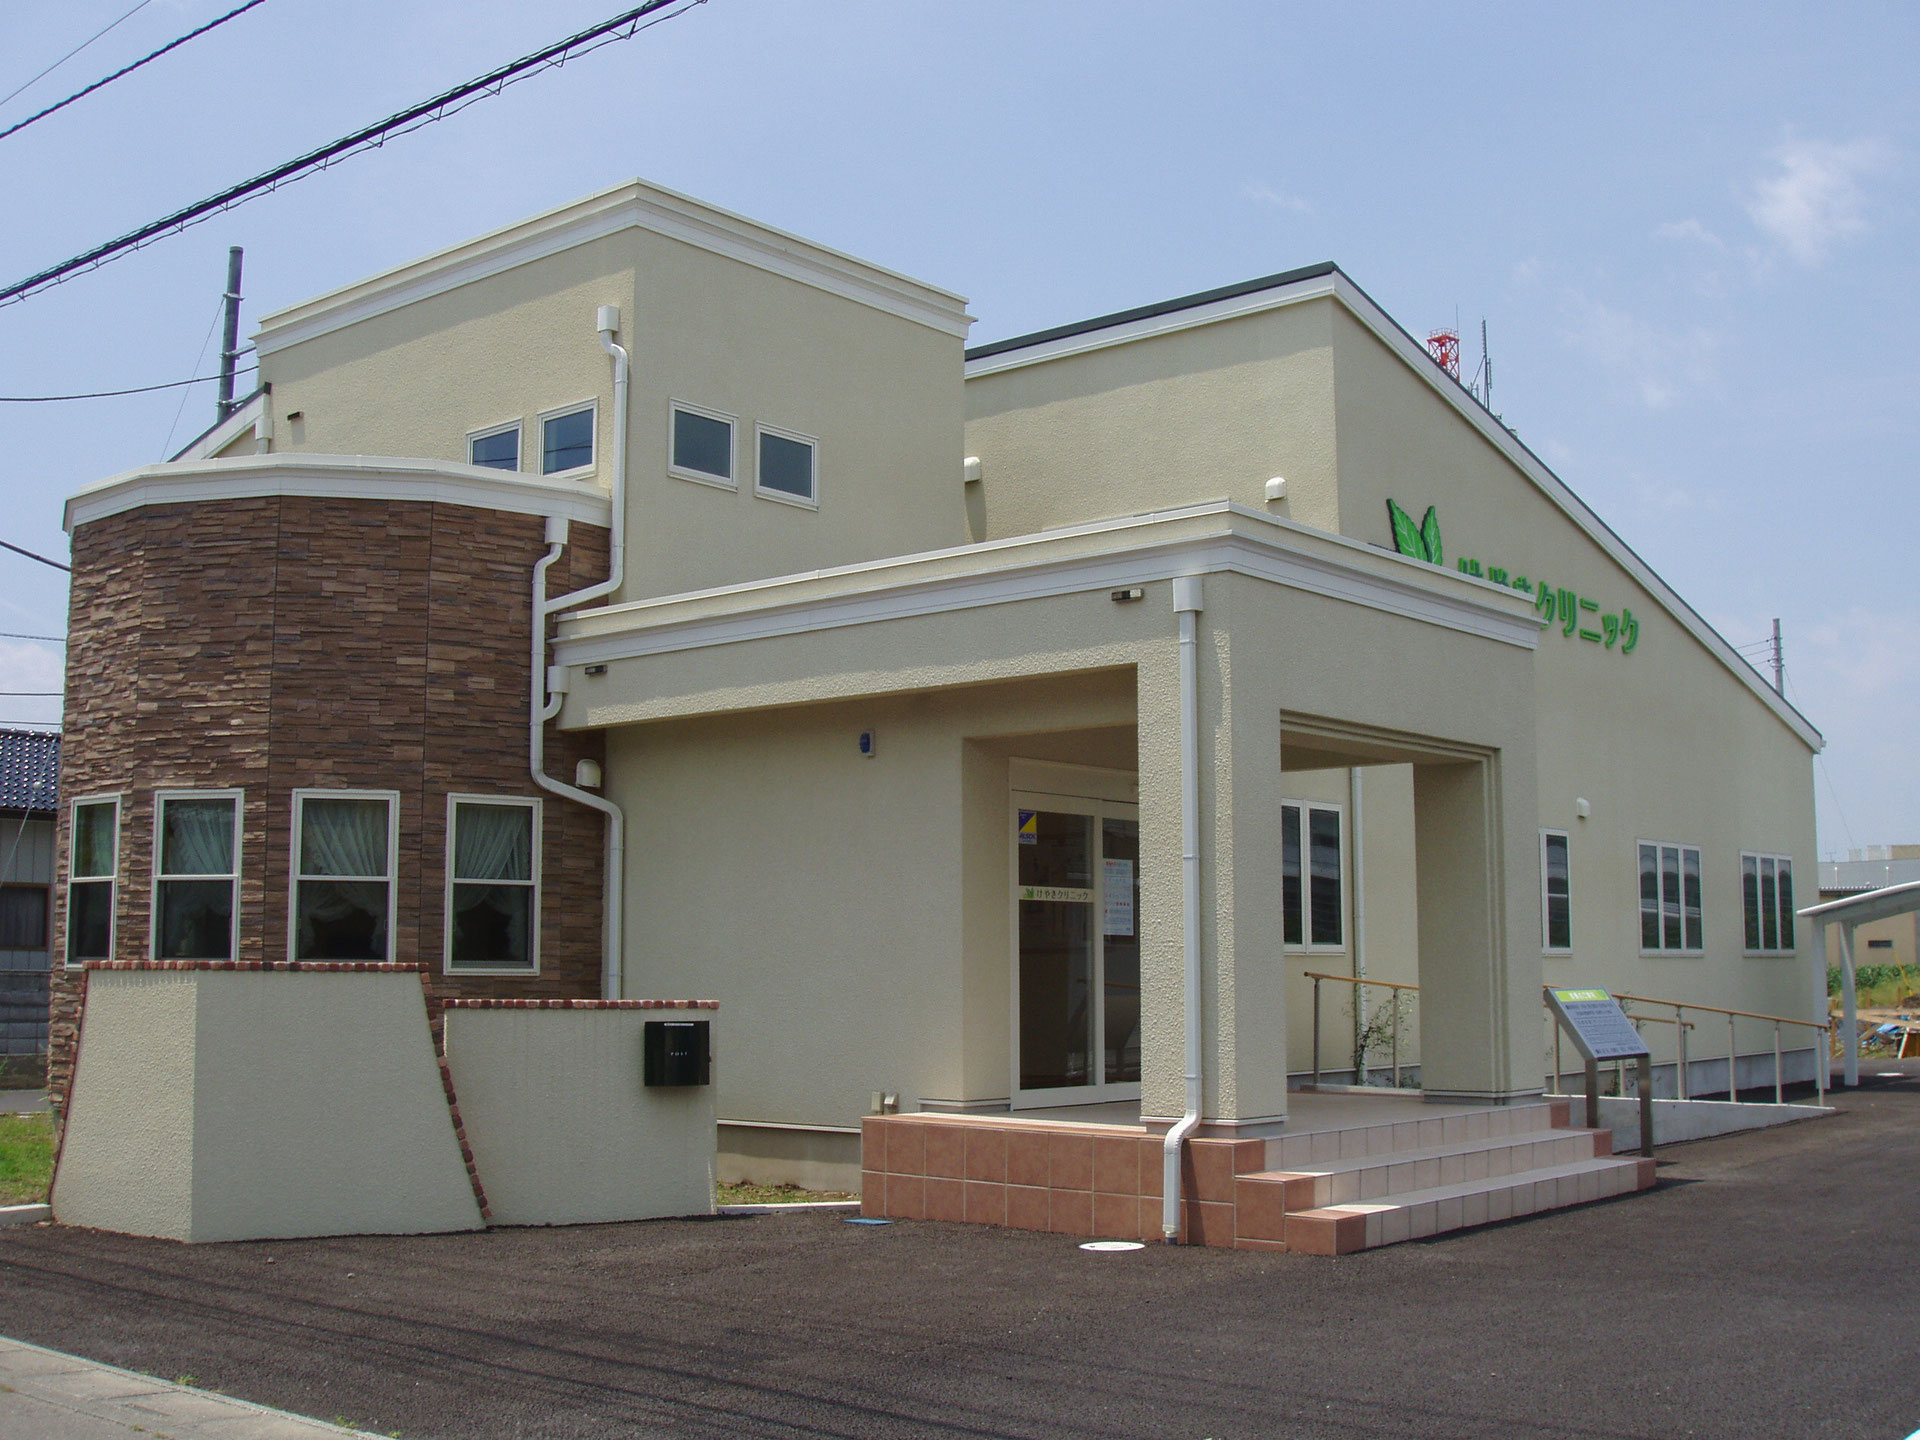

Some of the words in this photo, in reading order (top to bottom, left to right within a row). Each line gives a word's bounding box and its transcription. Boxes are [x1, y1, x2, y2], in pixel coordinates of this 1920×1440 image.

[1036, 889, 1089, 900] けやきクリニック
